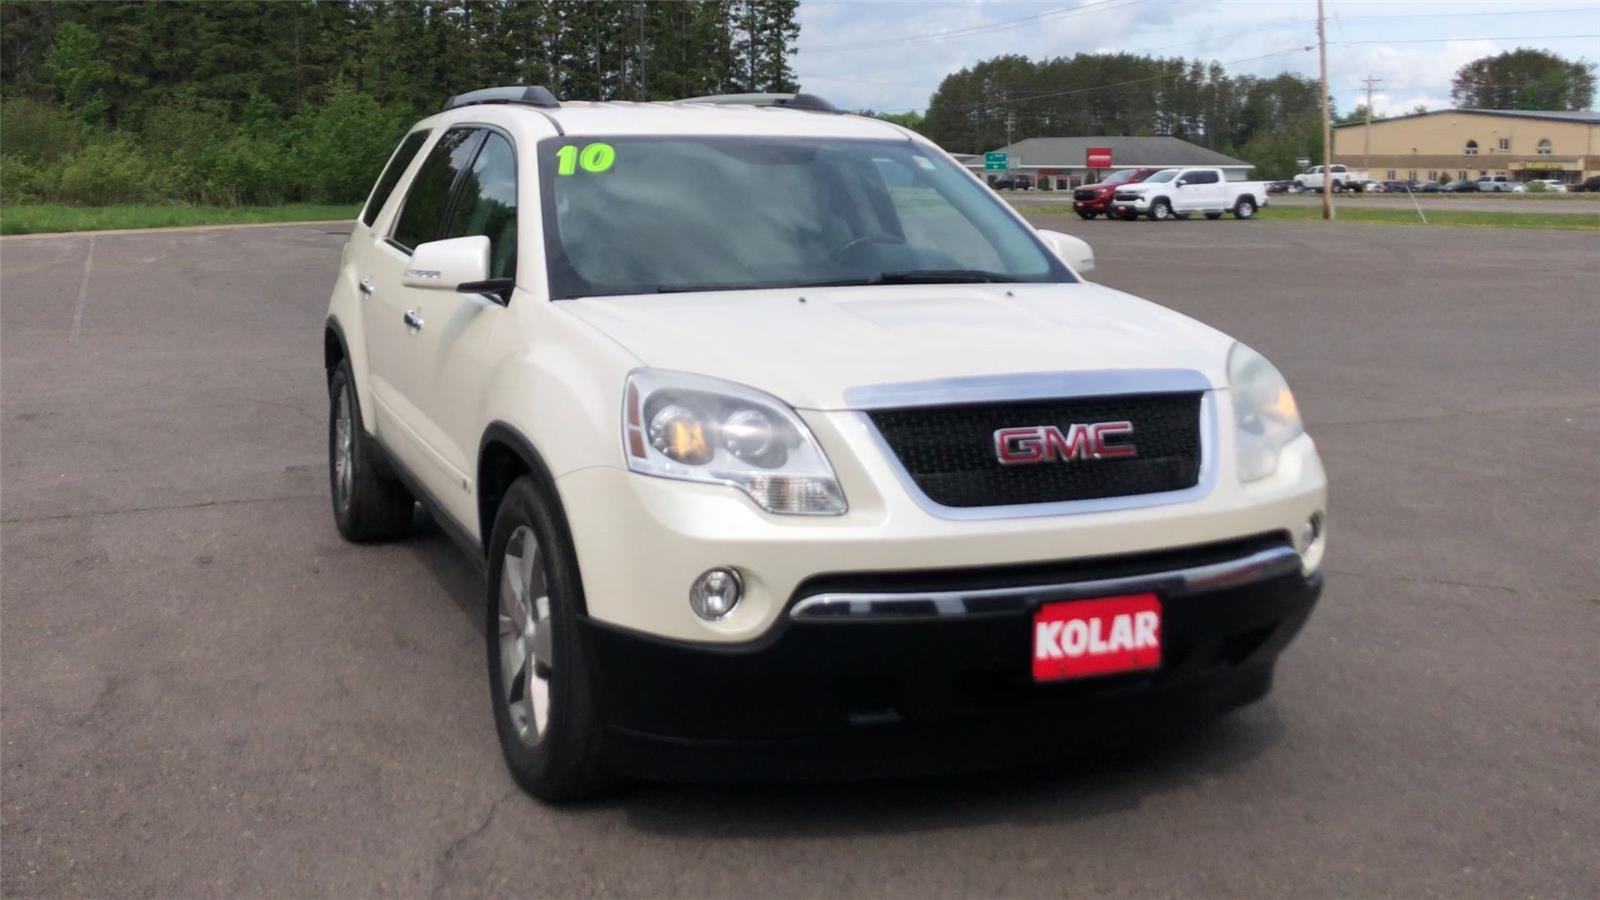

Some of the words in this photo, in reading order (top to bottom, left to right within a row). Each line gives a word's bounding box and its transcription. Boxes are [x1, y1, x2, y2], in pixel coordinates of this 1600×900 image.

[556, 142, 615, 176] 10
[993, 421, 1137, 464] GMC
[1035, 610, 1160, 660] KOLAR
